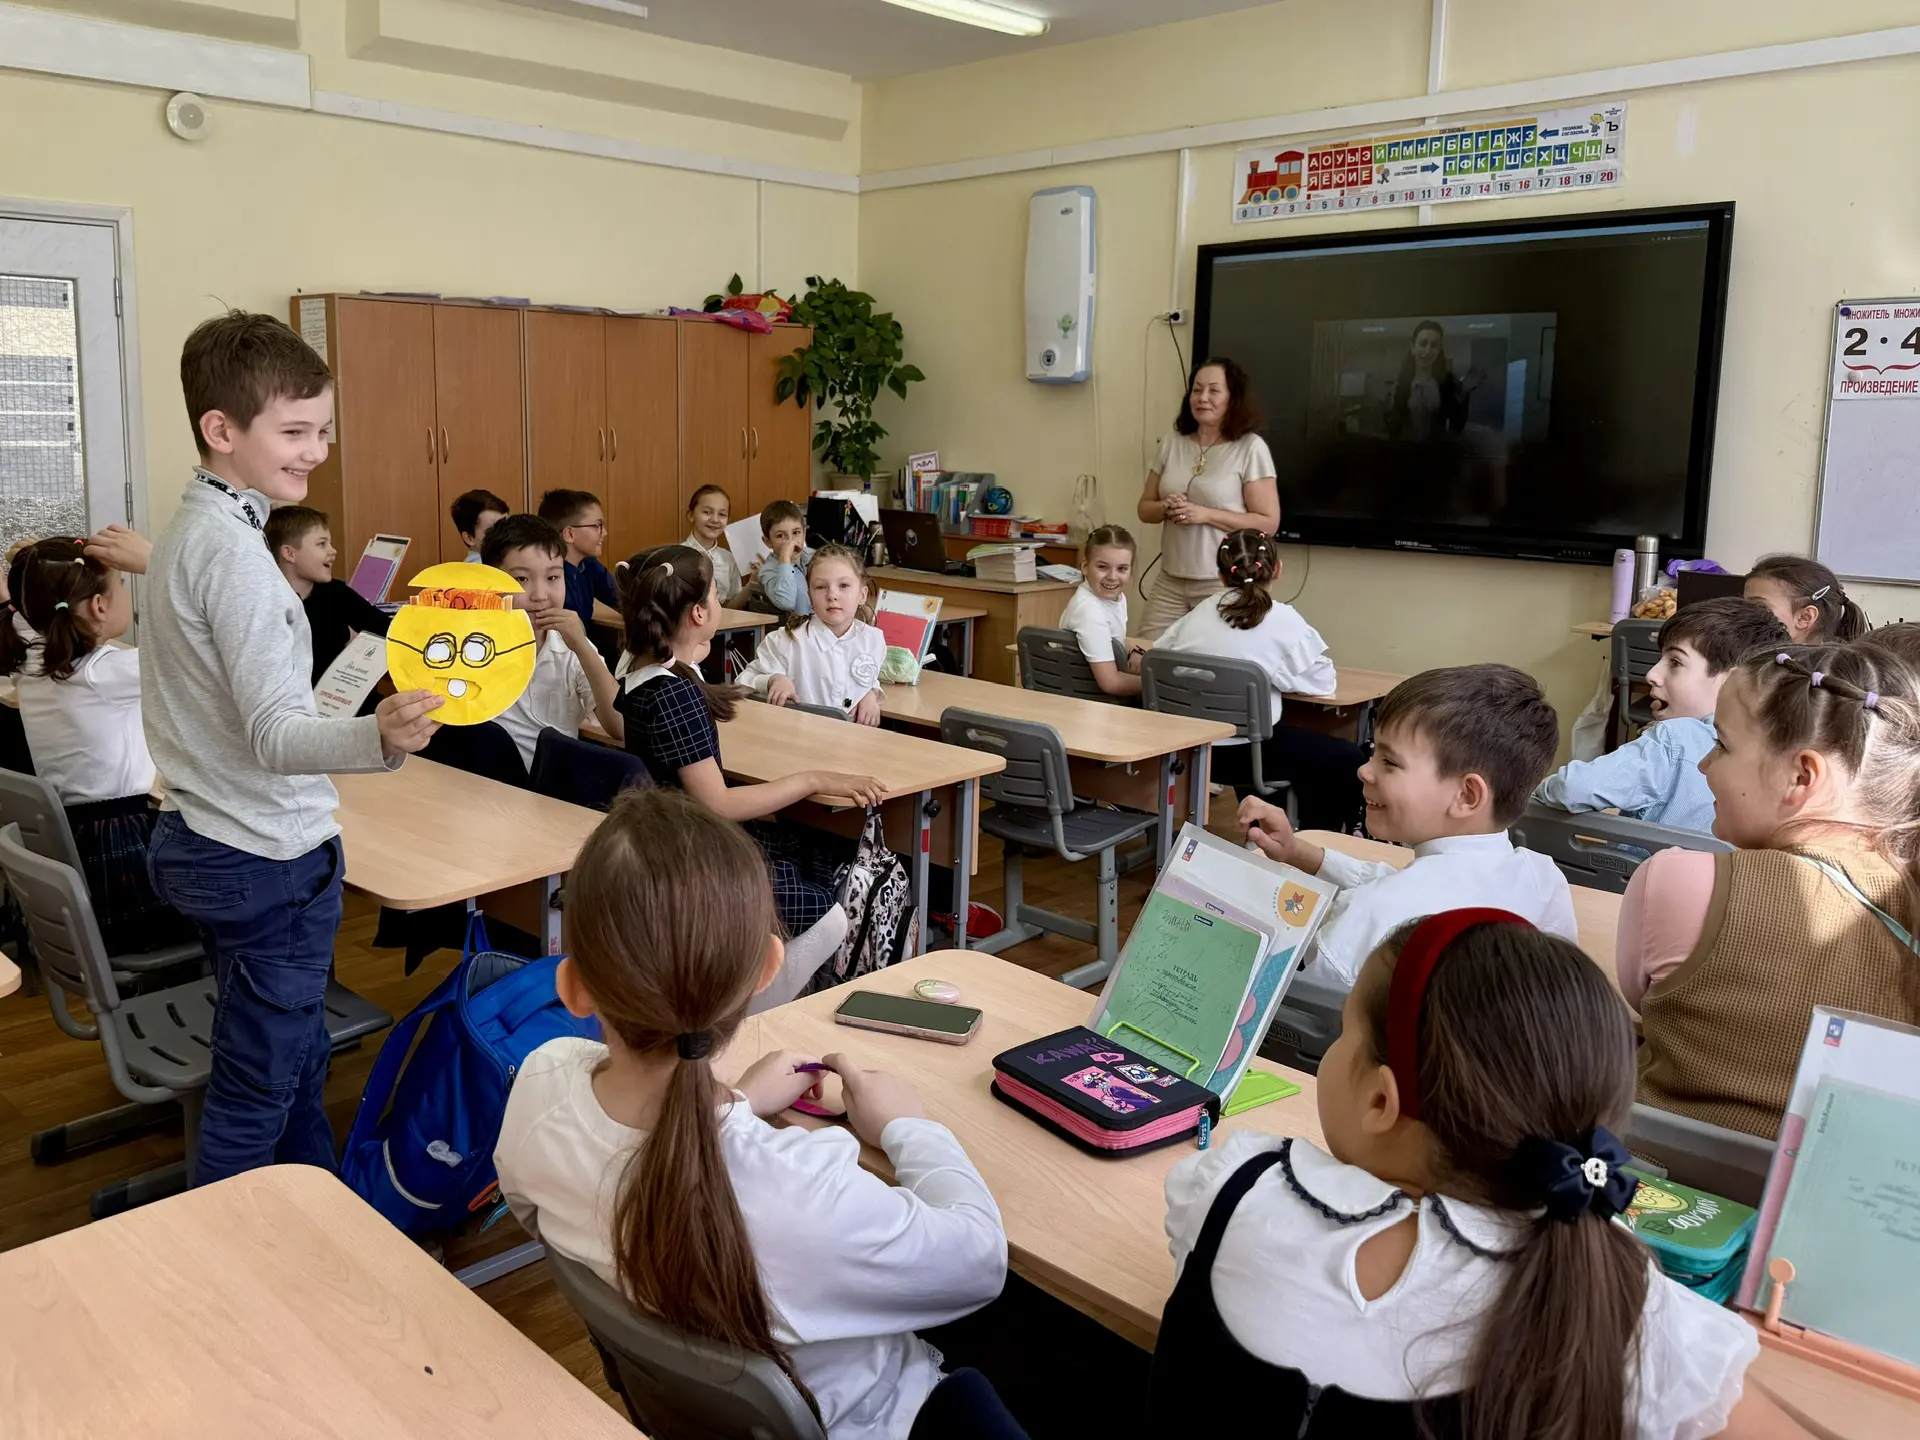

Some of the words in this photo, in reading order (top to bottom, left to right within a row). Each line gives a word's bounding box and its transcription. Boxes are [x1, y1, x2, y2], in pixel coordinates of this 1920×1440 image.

[1606, 121, 1619, 132] Ъ
[1606, 144, 1616, 154] Ь
[1242, 209, 1247, 218] 0
[1273, 206, 1278, 215] 2
[1289, 204, 1295, 212] 3
[1322, 201, 1327, 210] 5
[1338, 200, 1344, 208] 6
[1356, 198, 1361, 206] 7
[1372, 196, 1378, 204] 8
[1389, 194, 1395, 202] 9
[1404, 191, 1414, 201] 10
[1421, 189, 1431, 198] 11
[1440, 188, 1451, 197] 12
[1460, 185, 1471, 195] 13
[1478, 184, 1490, 194] 14
[1499, 182, 1510, 192] 15
[1518, 180, 1530, 190] 16
[1539, 178, 1551, 187] 17
[1559, 176, 1571, 185] 18
[1580, 174, 1592, 184] 19
[1600, 171, 1613, 181] 20
[1844, 328, 1868, 355] 2
[1901, 326, 1920, 355] 4
[1840, 380, 1918, 395] ПРОИЗВЕДЕНИЕ
[1173, 965, 1198, 982] ТЕТРАДЬ
